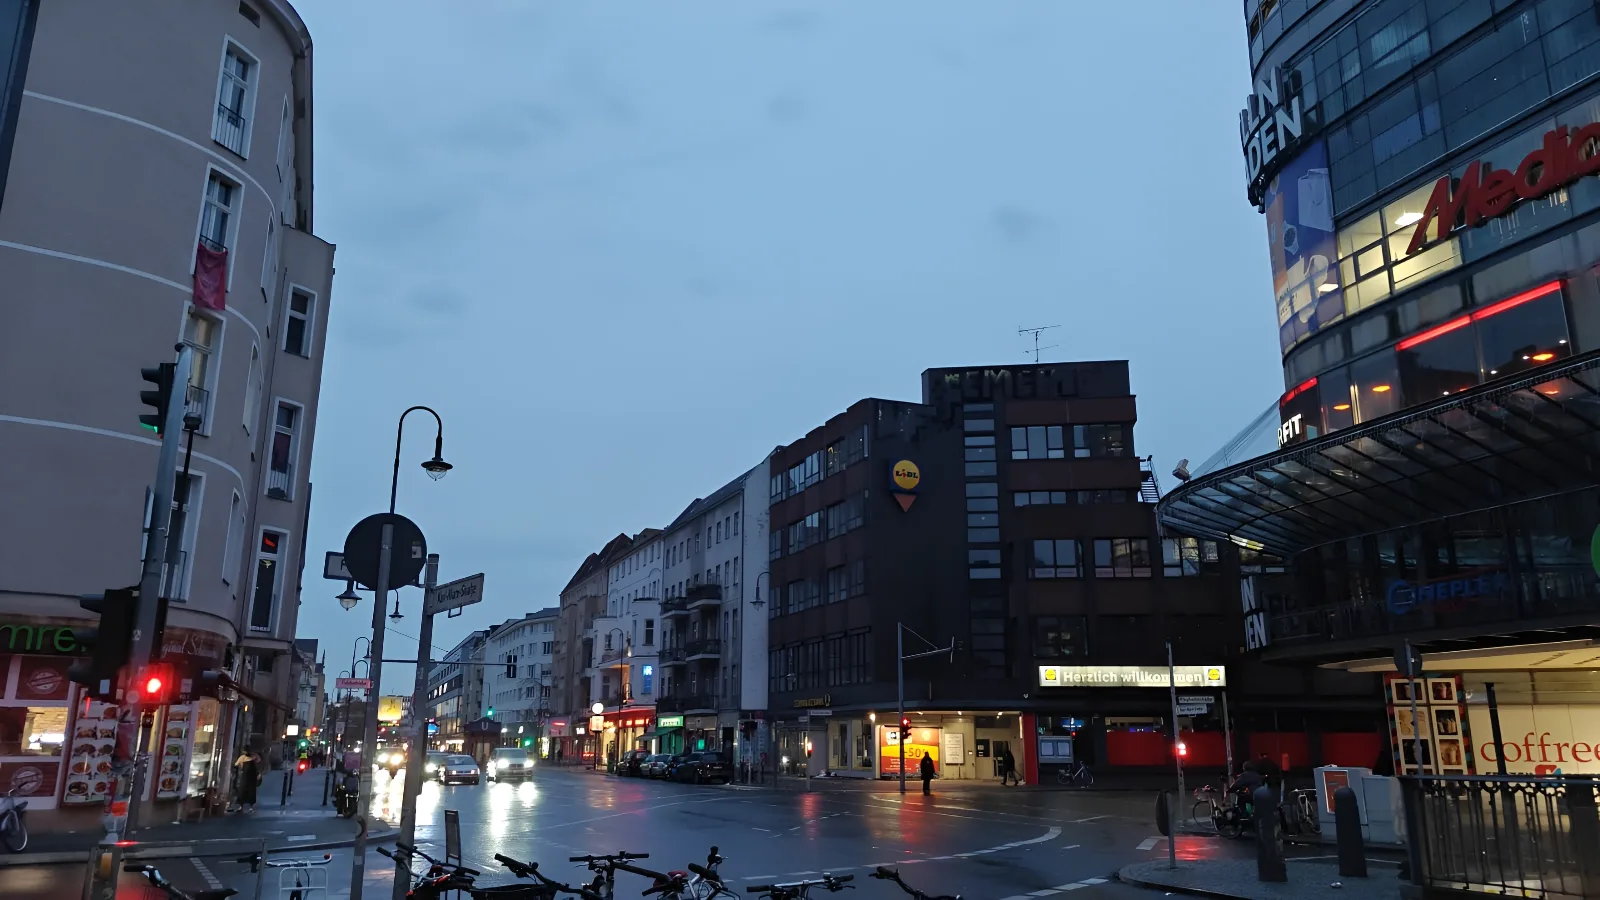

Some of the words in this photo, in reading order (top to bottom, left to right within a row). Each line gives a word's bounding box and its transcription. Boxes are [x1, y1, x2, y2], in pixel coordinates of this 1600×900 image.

[1246, 96, 1302, 187] DEN
[1278, 413, 1302, 448] RFIT
[1063, 670, 1118, 683] Herzlich
[1120, 670, 1202, 683] willkommen
